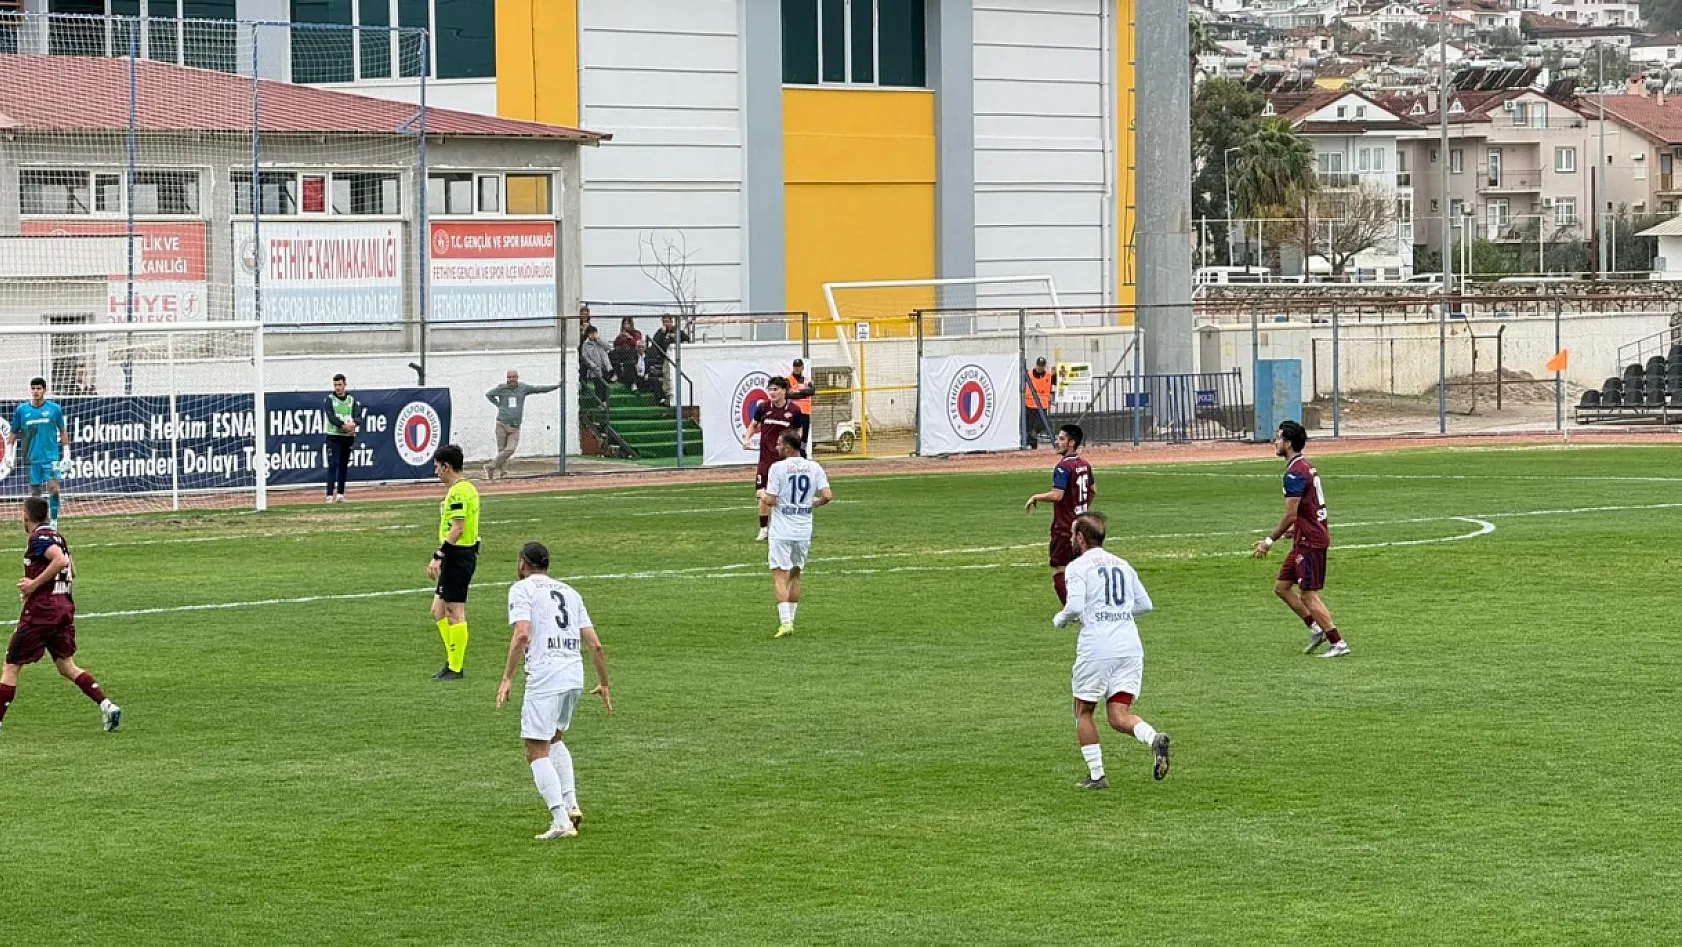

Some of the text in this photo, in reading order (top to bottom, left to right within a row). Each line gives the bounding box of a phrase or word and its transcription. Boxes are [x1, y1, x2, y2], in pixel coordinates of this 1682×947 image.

[144, 233, 180, 251] LİK VE
[270, 229, 397, 279] FETHİYE KAYMAKAMLIĞI
[493, 235, 503, 249] VE
[503, 234, 520, 249] SPOR
[489, 265, 504, 280] SPOR
[110, 291, 177, 313] HİYE
[74, 414, 145, 443] Lokman
[151, 412, 206, 440] Hekim
[212, 411, 256, 438] ESNA
[184, 446, 238, 479] Dolayı
[788, 474, 811, 505] 19
[1097, 566, 1125, 606] 10
[550, 590, 569, 629] 3
